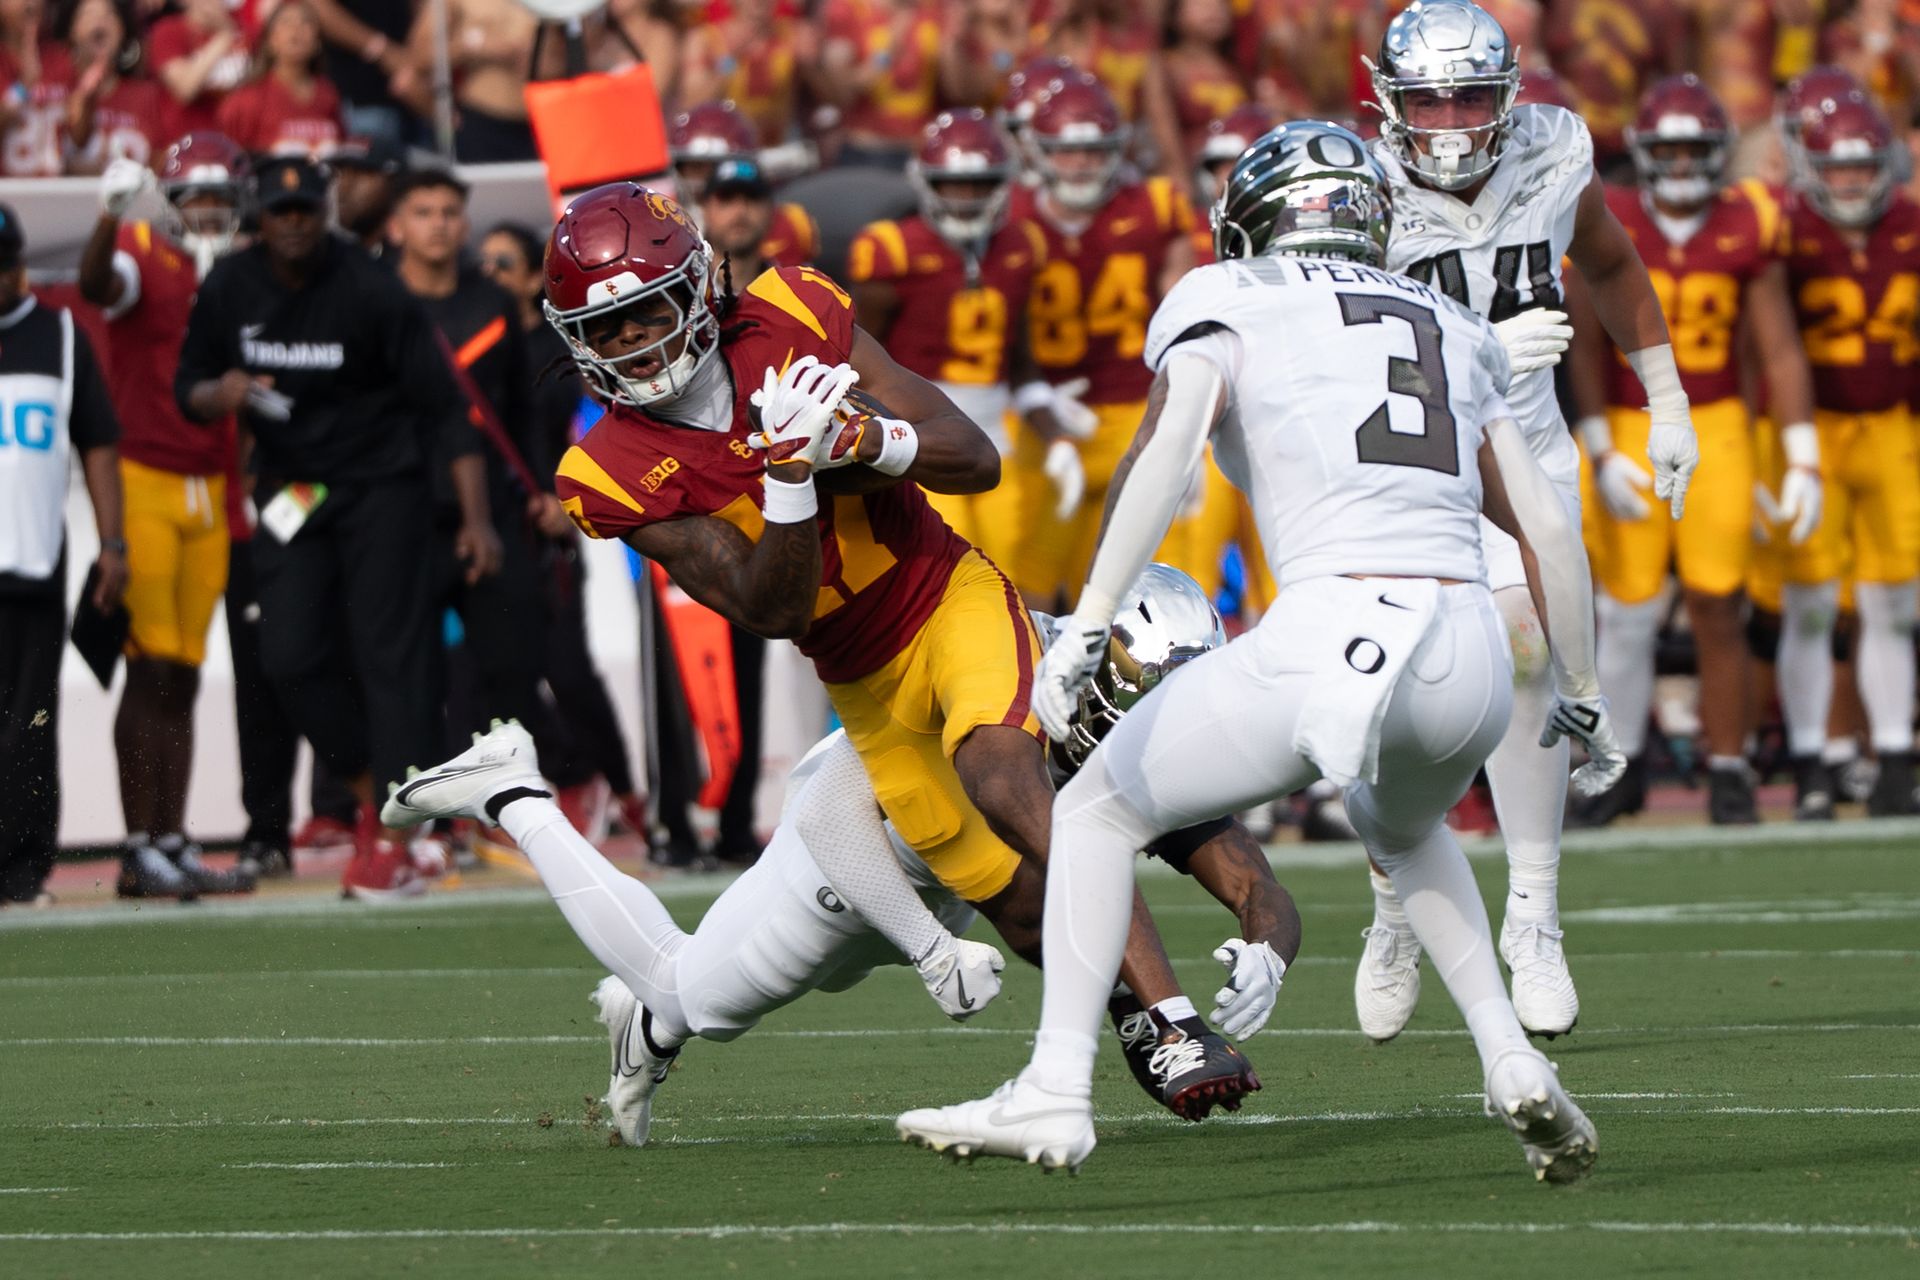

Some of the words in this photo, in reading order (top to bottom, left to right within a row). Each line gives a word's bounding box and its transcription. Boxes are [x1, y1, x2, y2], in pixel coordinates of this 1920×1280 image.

[1307, 133, 1364, 167] O
[241, 340, 344, 368] TROJANS
[941, 287, 1006, 385] 9
[1028, 259, 1148, 366] 84
[1802, 271, 1919, 368] 24
[1336, 292, 1459, 476] 3
[1345, 636, 1386, 674] O
